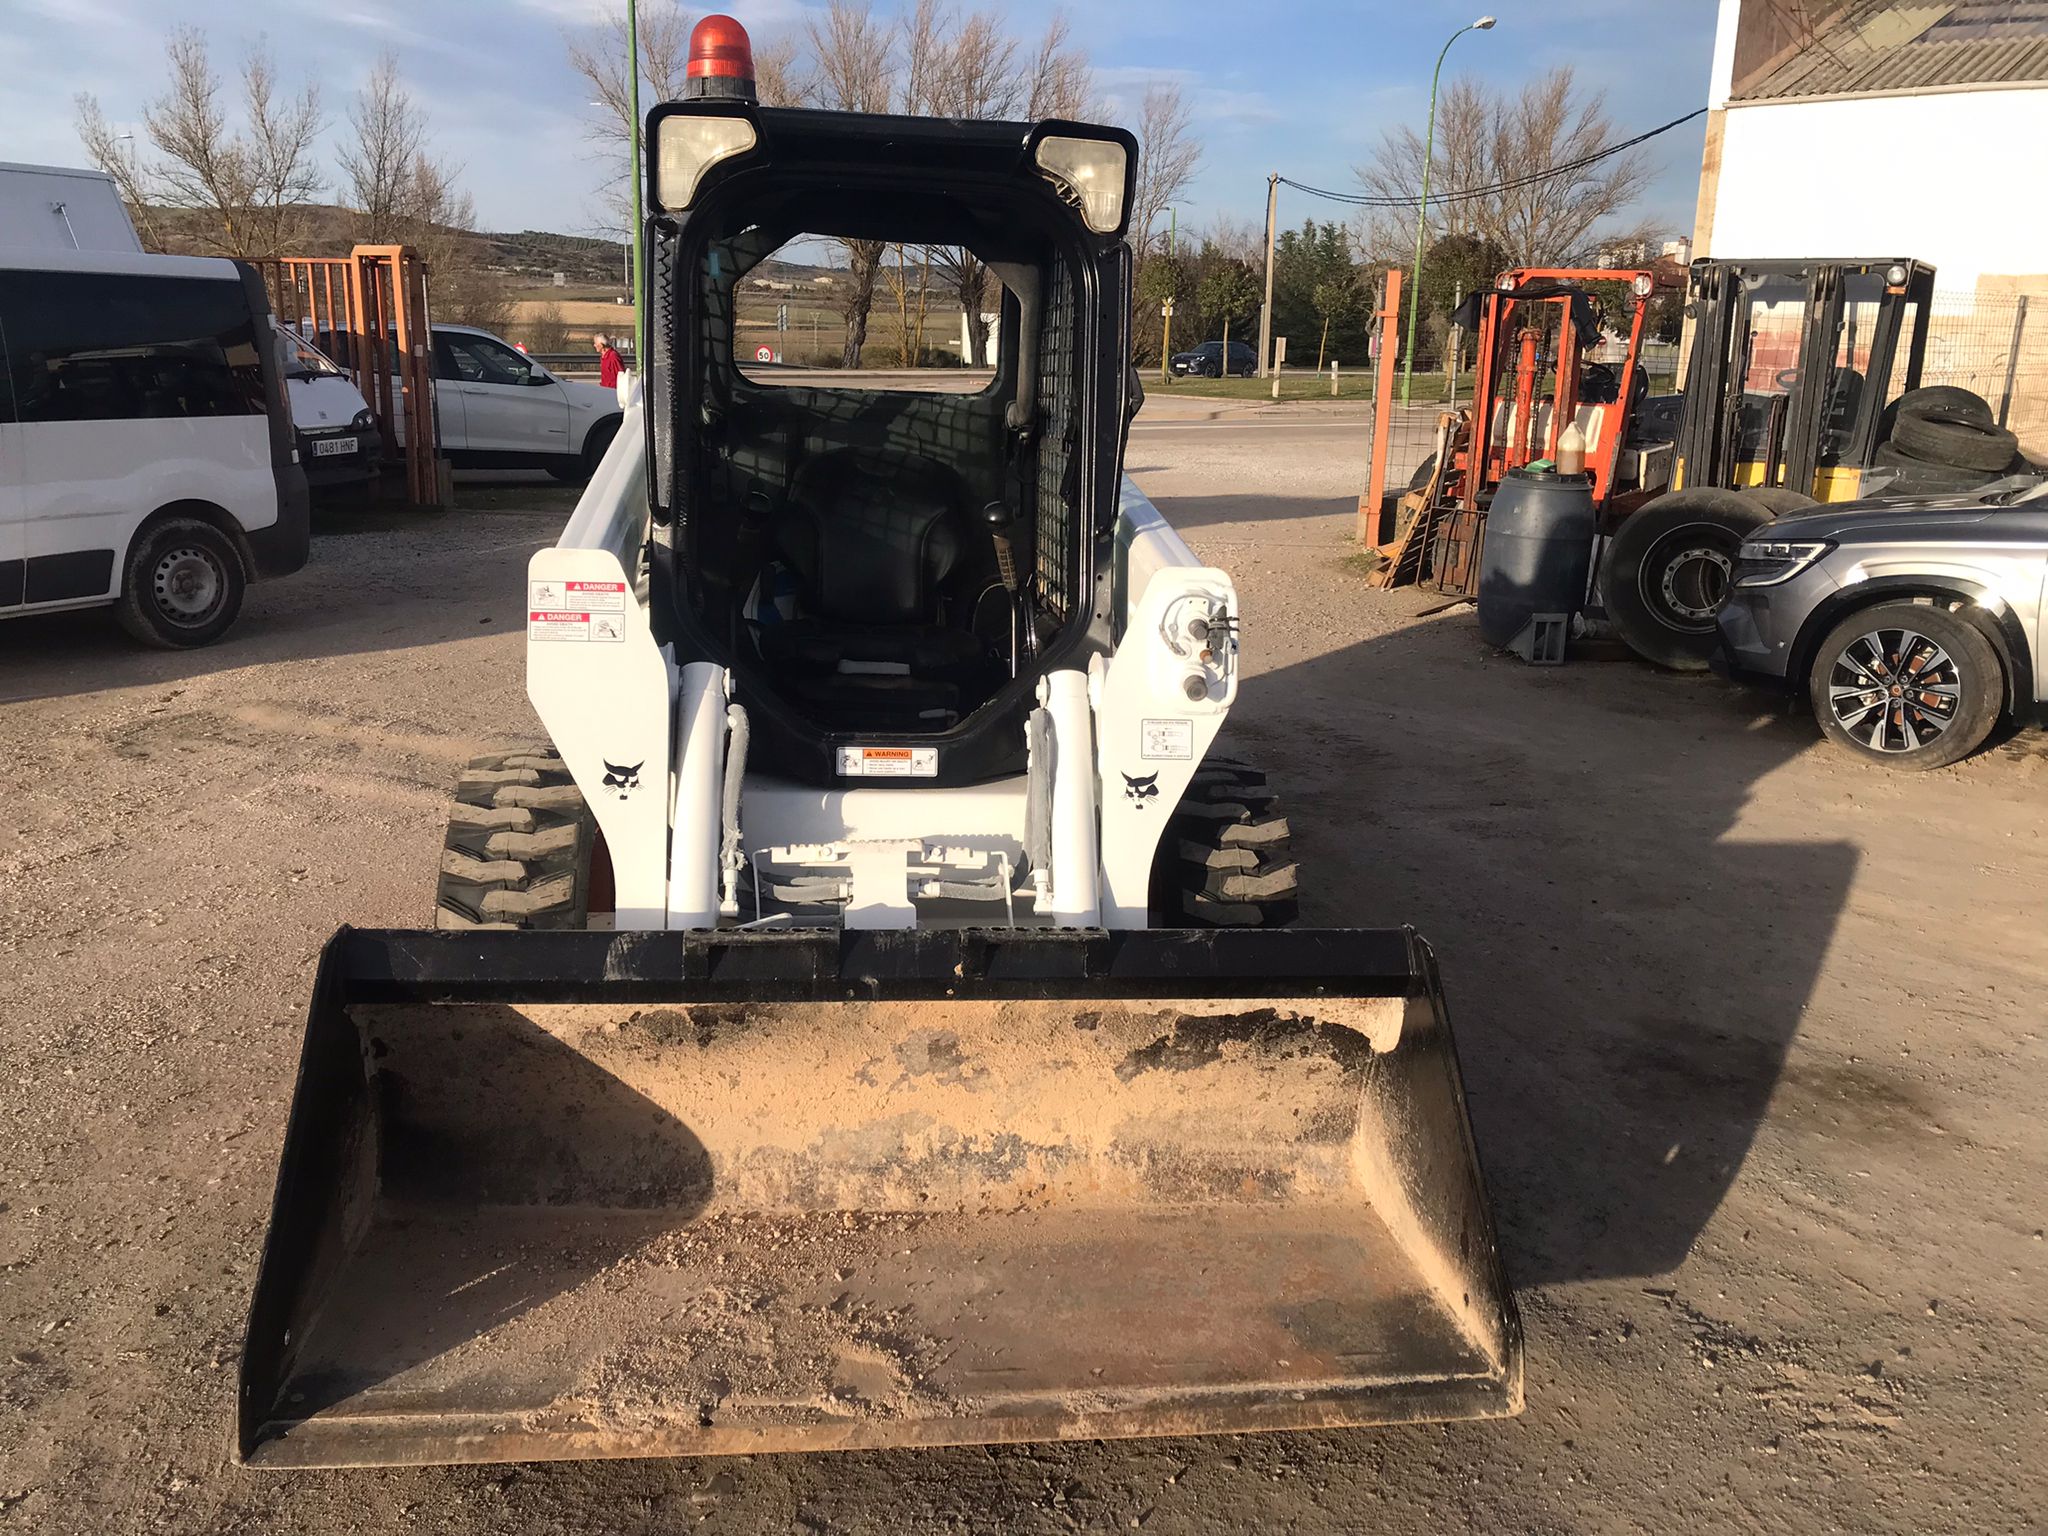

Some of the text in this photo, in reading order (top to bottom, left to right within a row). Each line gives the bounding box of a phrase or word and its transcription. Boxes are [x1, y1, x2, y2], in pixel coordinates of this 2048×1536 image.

[320, 440, 355, 454] 0481 HNF
[583, 583, 618, 591] DANGER
